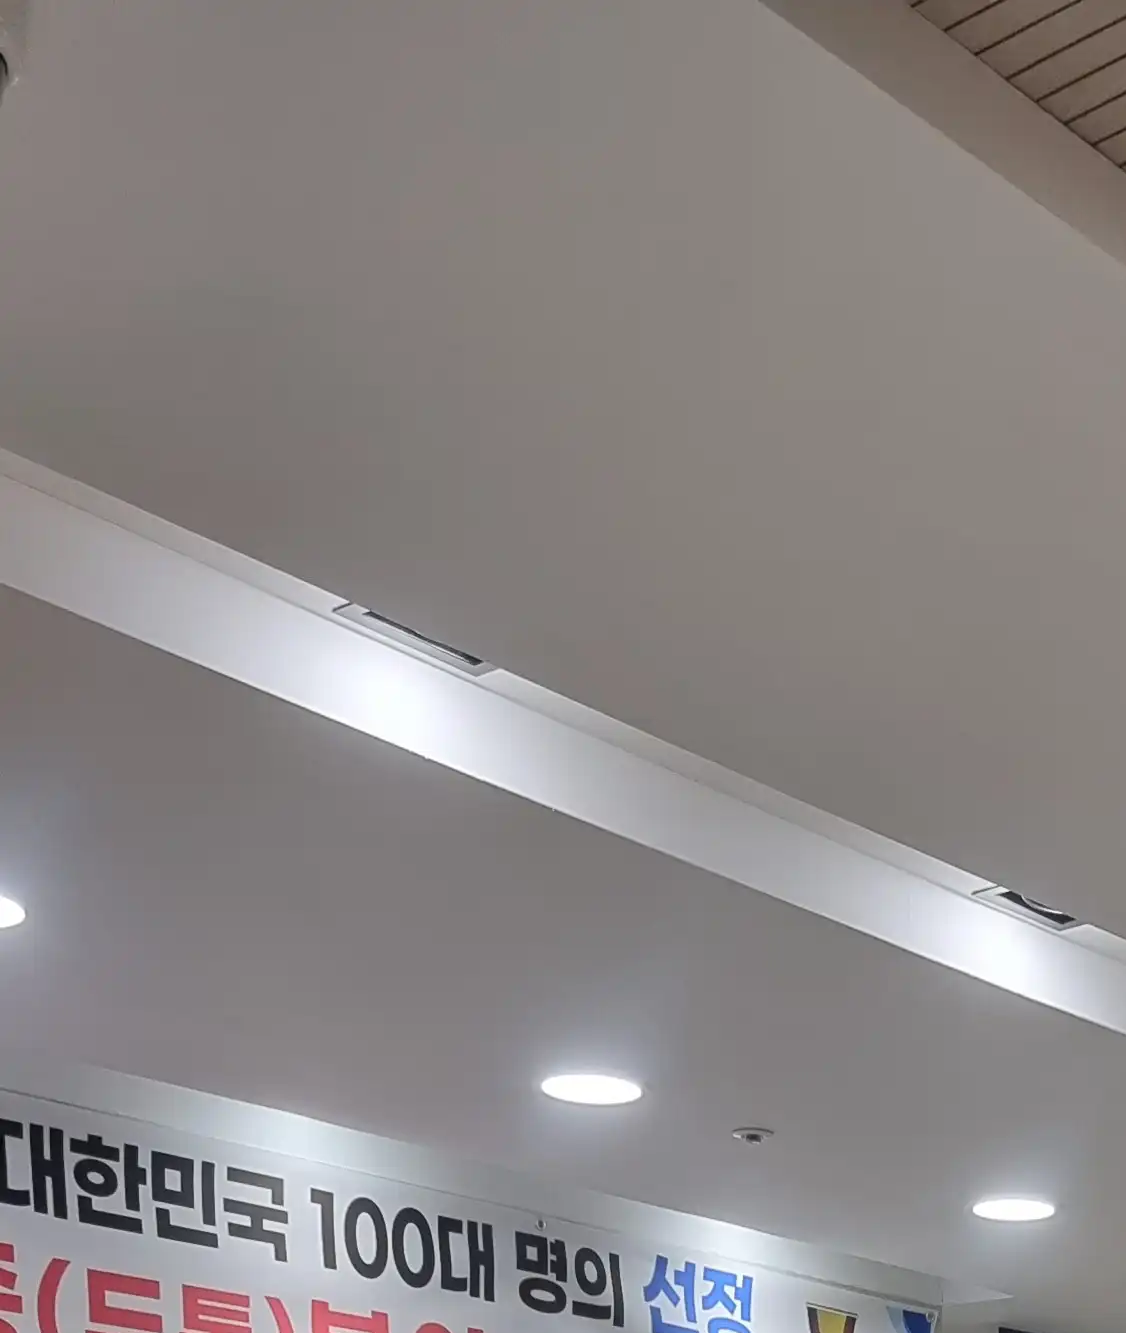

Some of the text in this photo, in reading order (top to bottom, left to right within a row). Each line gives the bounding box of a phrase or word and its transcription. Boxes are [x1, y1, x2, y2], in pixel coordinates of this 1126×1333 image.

[0, 1118, 289, 1263] 대한민국
[310, 1187, 496, 1302] 100대
[516, 1231, 624, 1327] 명의
